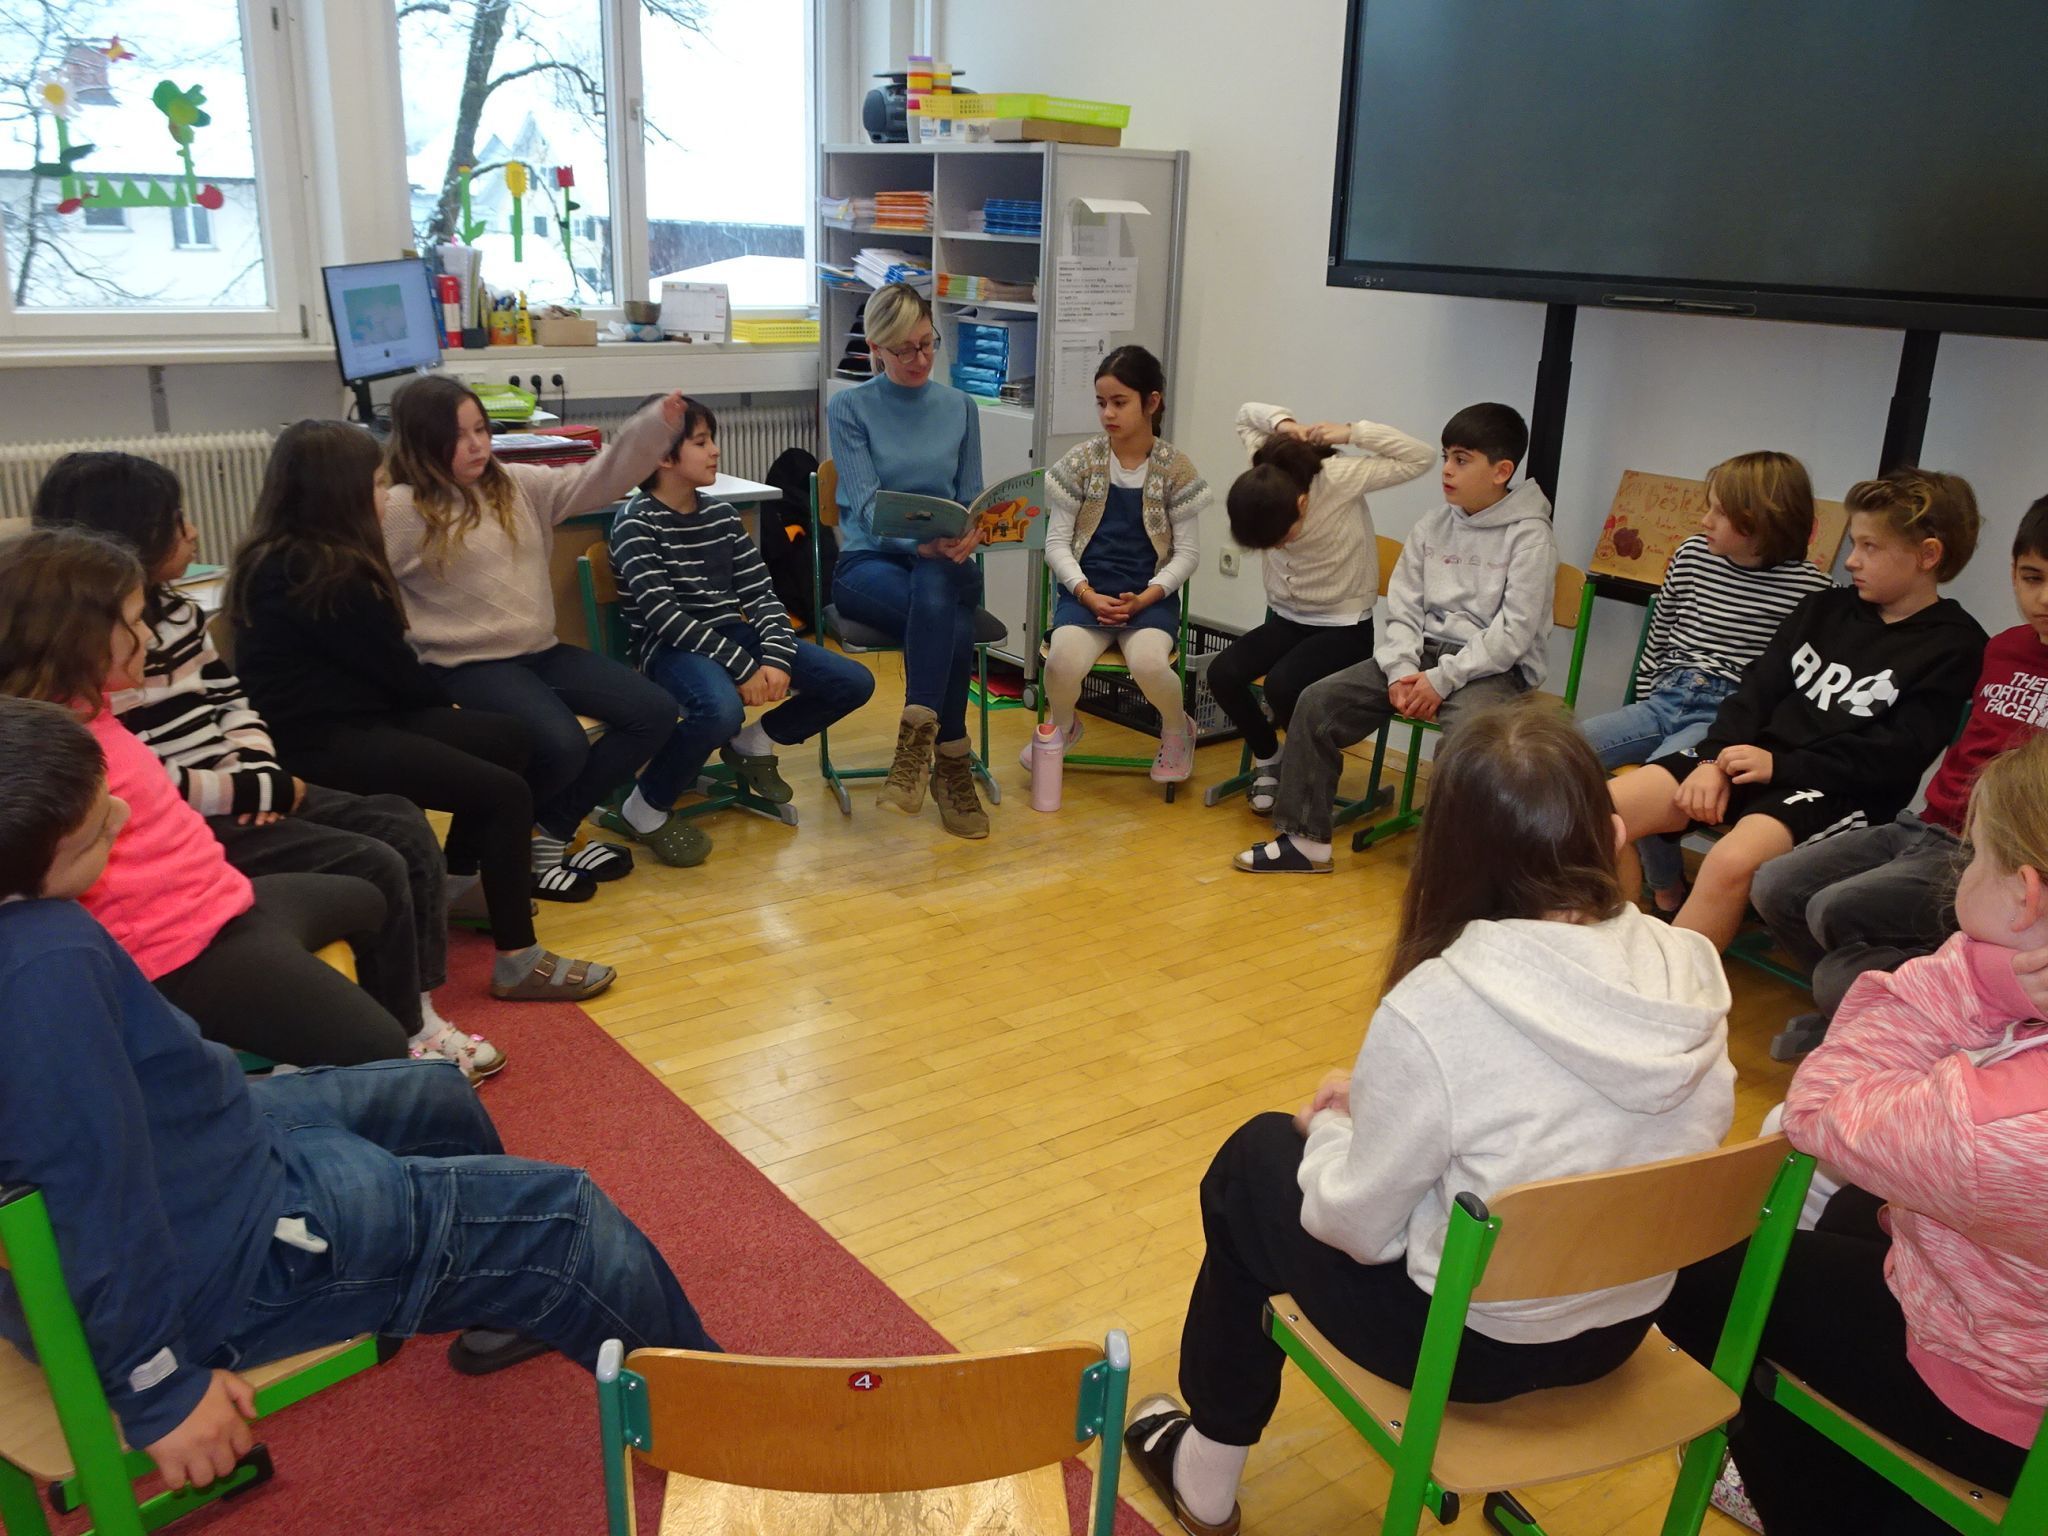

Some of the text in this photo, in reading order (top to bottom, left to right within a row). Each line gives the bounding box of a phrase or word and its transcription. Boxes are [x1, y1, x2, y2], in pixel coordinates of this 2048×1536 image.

[2010, 671, 2047, 692] THE
[1979, 683, 2039, 708] NORTH
[1984, 698, 2032, 722] FACE
[854, 1374, 873, 1389] 4
